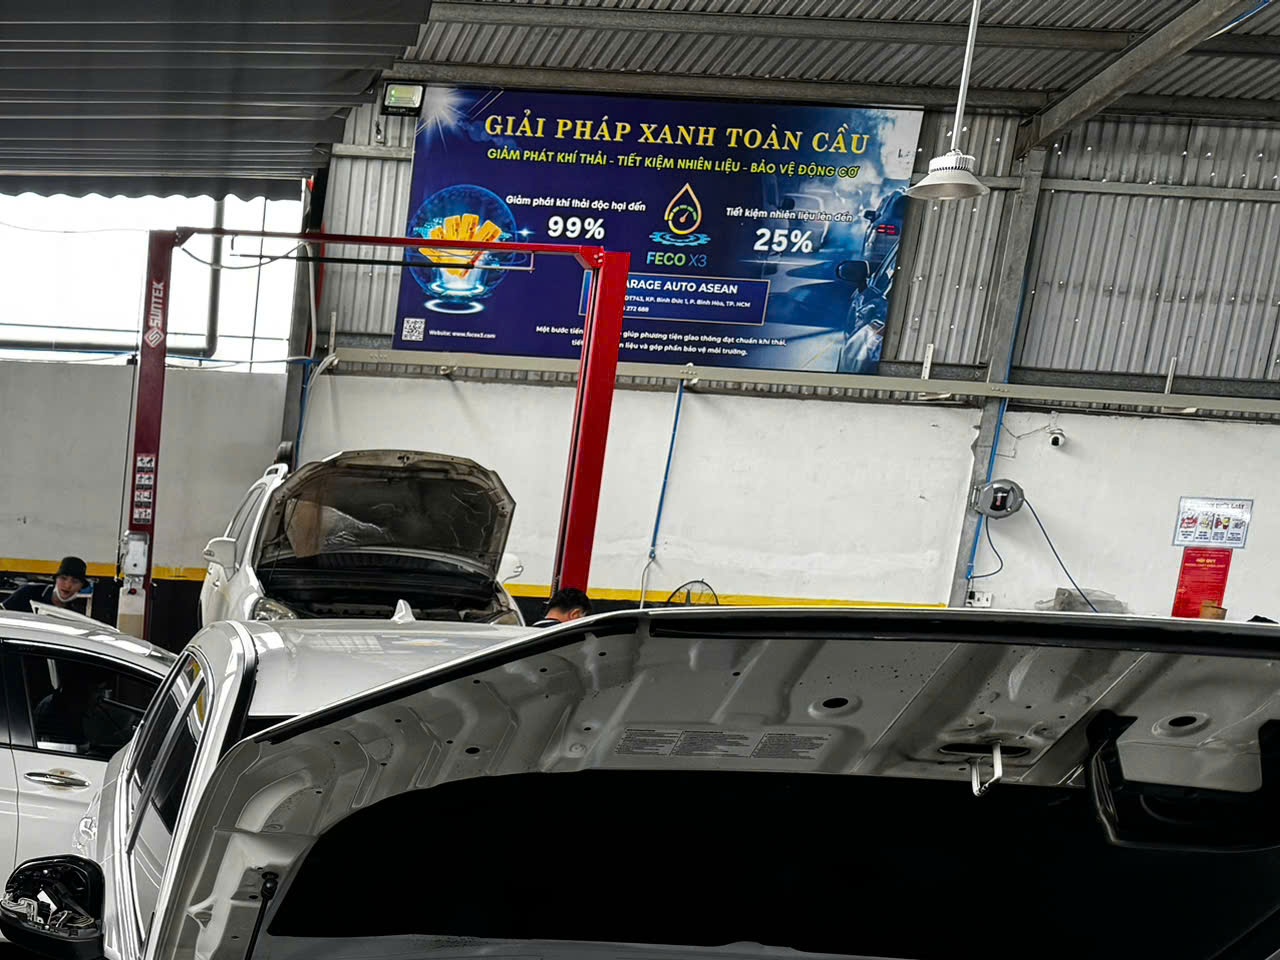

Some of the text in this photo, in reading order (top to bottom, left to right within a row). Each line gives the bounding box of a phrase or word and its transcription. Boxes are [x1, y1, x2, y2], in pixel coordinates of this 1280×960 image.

[484, 109, 870, 154] GIẢI PHÁP XANH TOÀN CẦU
[487, 145, 521, 161] GIẢM
[523, 148, 555, 163] PHÁT
[556, 150, 579, 164] KHÍ
[580, 150, 607, 166] THẢI
[617, 153, 643, 168] TIẾT
[644, 155, 675, 171] KIỆM
[678, 156, 712, 171] NHIÊN
[714, 158, 741, 175] LIỆU
[750, 159, 776, 174] BẢO
[779, 162, 795, 177] VỆ
[798, 163, 835, 179] ĐỘNG
[838, 166, 860, 179] CƠ
[506, 195, 646, 212] Giảm phát khí thải độc hại đến
[726, 206, 743, 217] Tiết
[744, 209, 768, 219] kiệm
[770, 209, 796, 219] nhiên
[798, 211, 816, 221] liệu
[548, 216, 605, 239] 99%
[753, 228, 813, 253] 25%
[646, 252, 707, 267] FECO X3
[663, 281, 697, 291] AUTO
[698, 283, 738, 294] ASEAN
